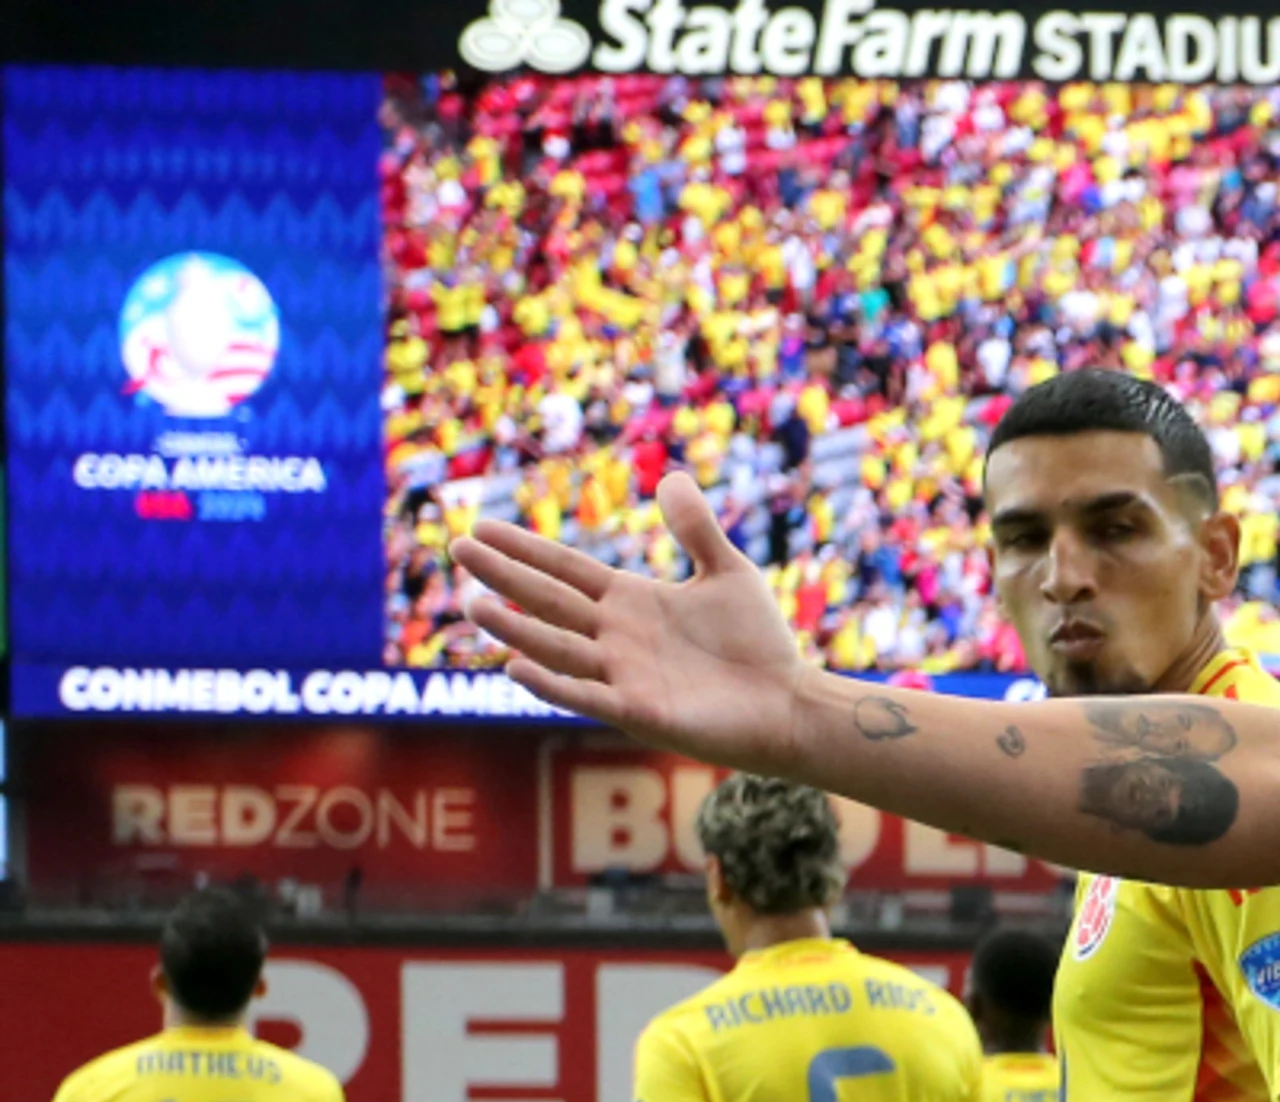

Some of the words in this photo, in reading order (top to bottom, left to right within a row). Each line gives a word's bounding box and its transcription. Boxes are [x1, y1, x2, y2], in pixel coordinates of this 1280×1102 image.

[74, 453, 167, 490] COPA
[60, 667, 299, 713] CONMEBOL
[302, 670, 418, 715] COPA
[419, 672, 580, 718] AMER
[112, 784, 476, 851] REDZONE
[705, 980, 853, 1032] RICHARD
[864, 977, 937, 1017] RIOS
[136, 1050, 283, 1086] MATHEUS
